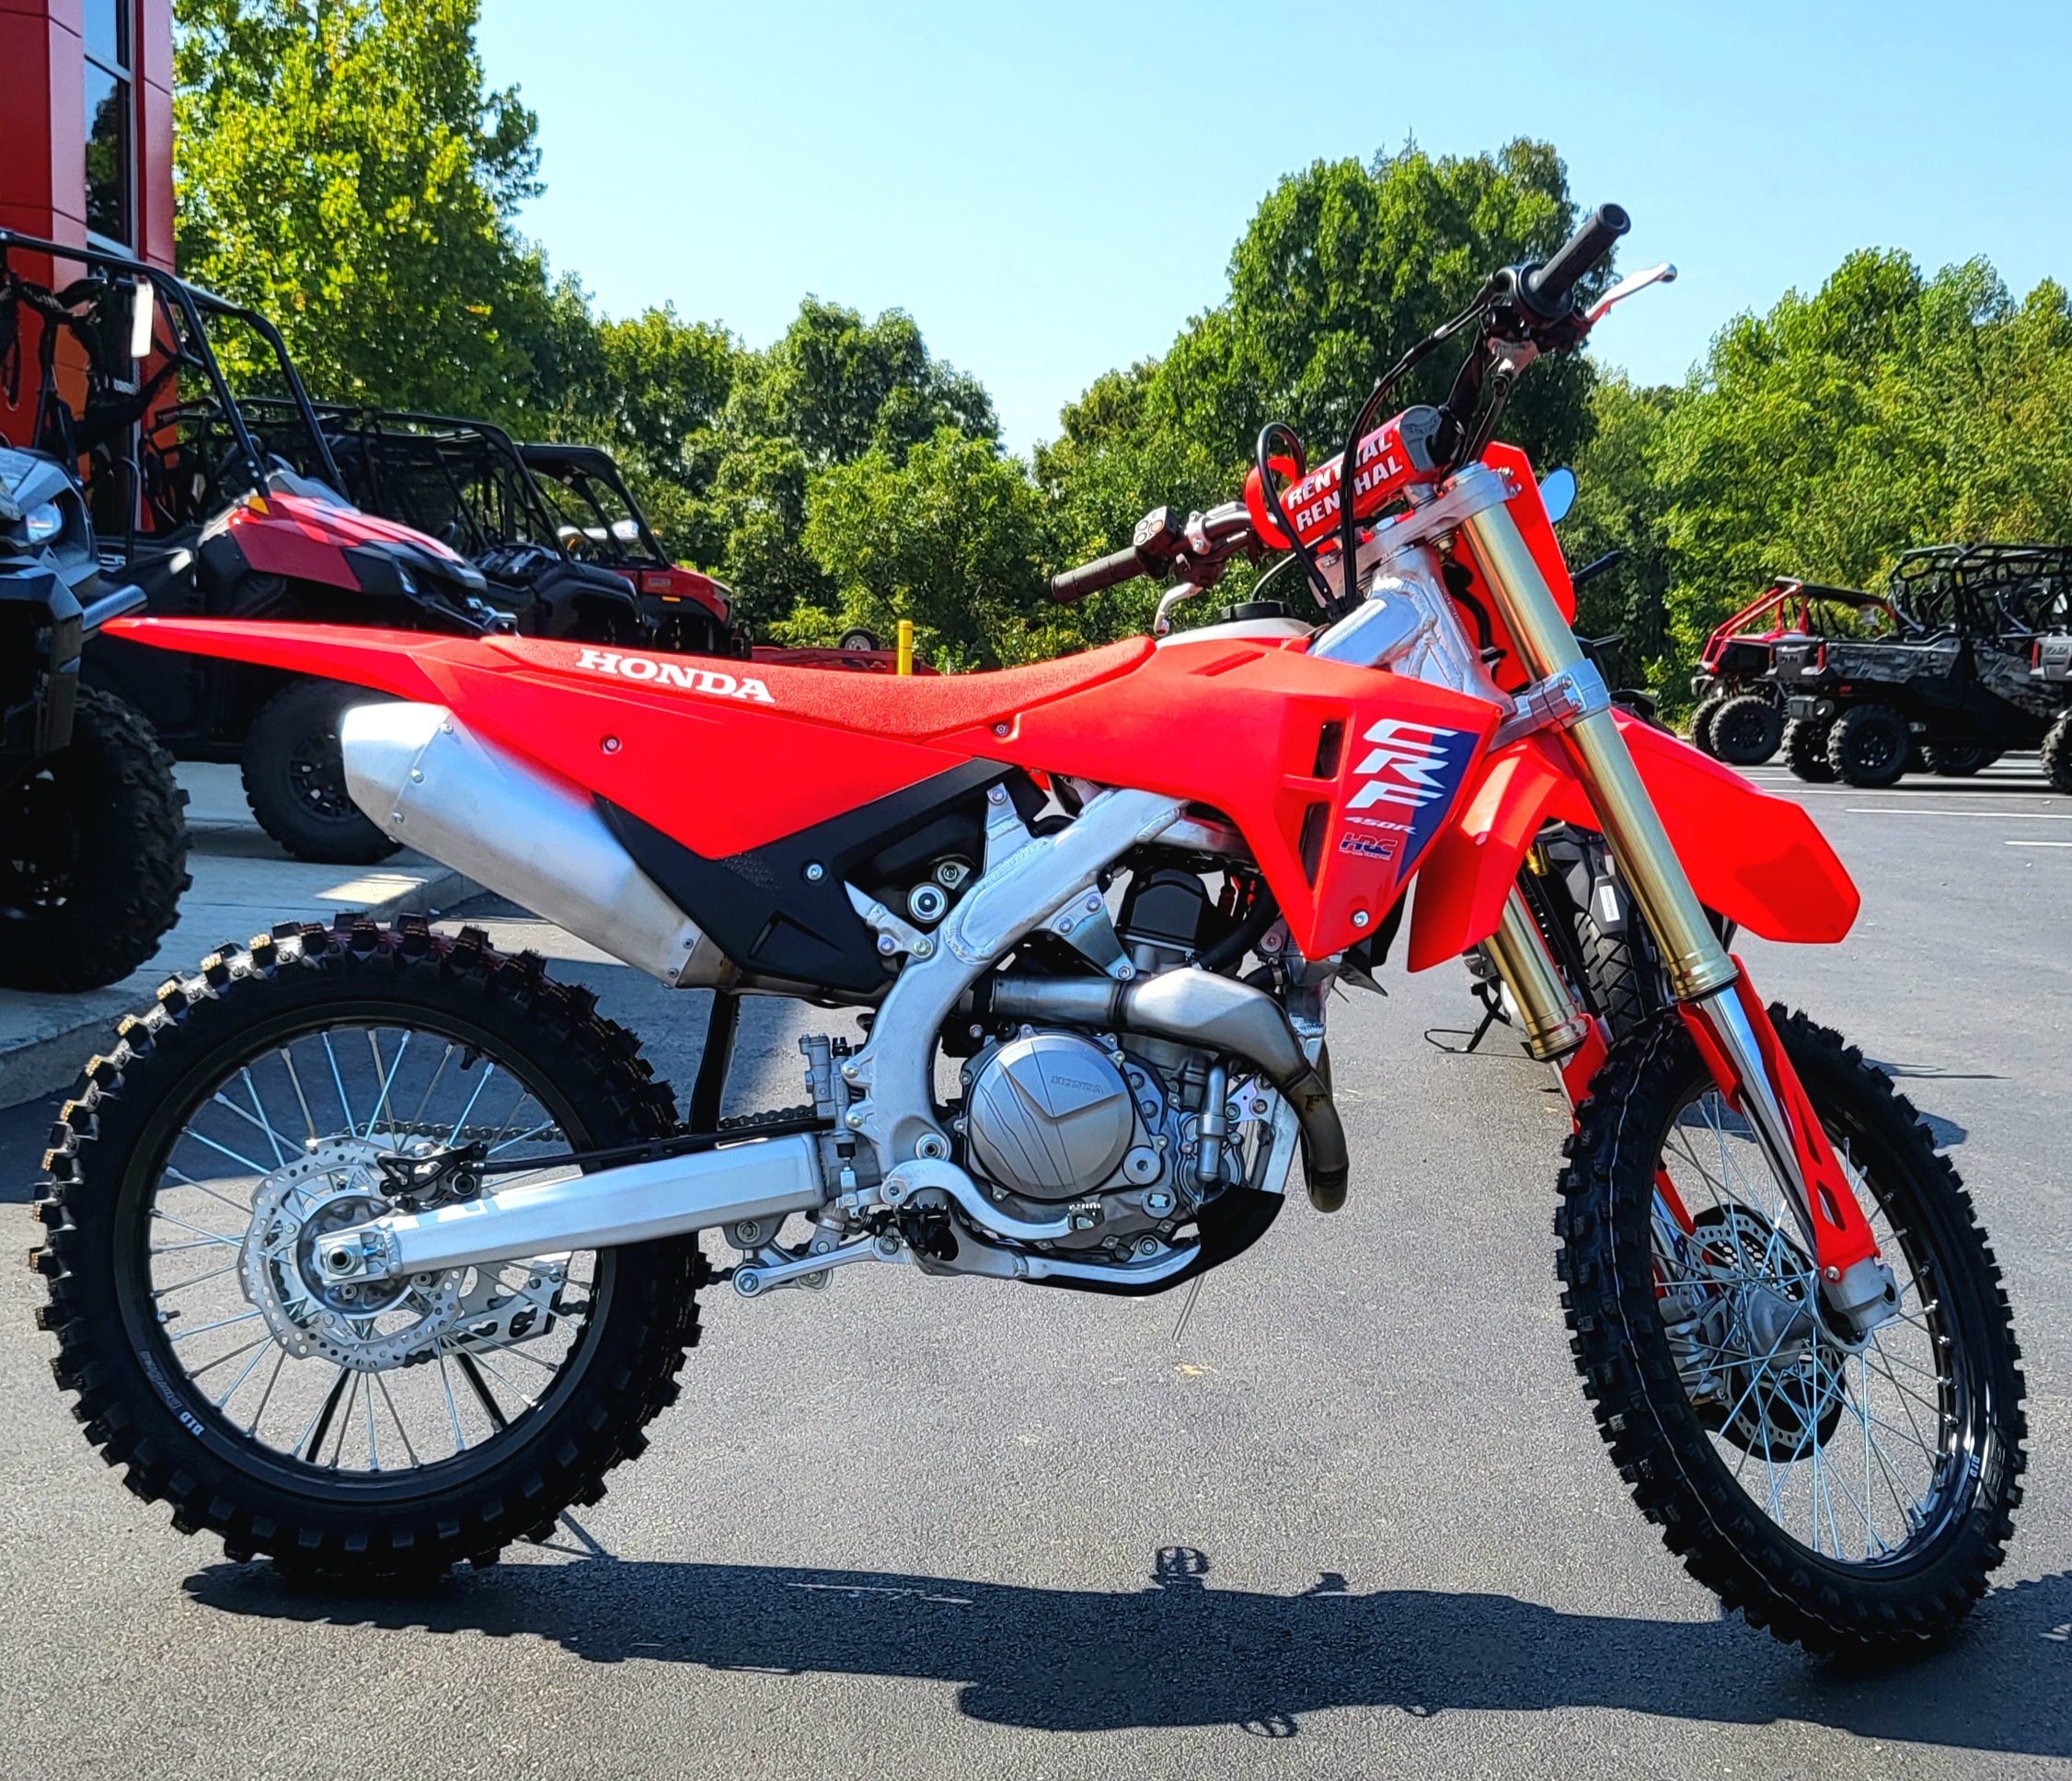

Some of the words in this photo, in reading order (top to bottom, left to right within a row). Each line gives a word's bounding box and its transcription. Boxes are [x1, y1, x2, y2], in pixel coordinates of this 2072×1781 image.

[1295, 455, 1403, 533] RENHAL
[576, 649, 776, 703] HONDA
[1345, 718, 1459, 809] CRF
[1339, 832, 1399, 856] HRC
[1344, 816, 1418, 835] 450R
[1051, 1075, 1104, 1095] HONDA
